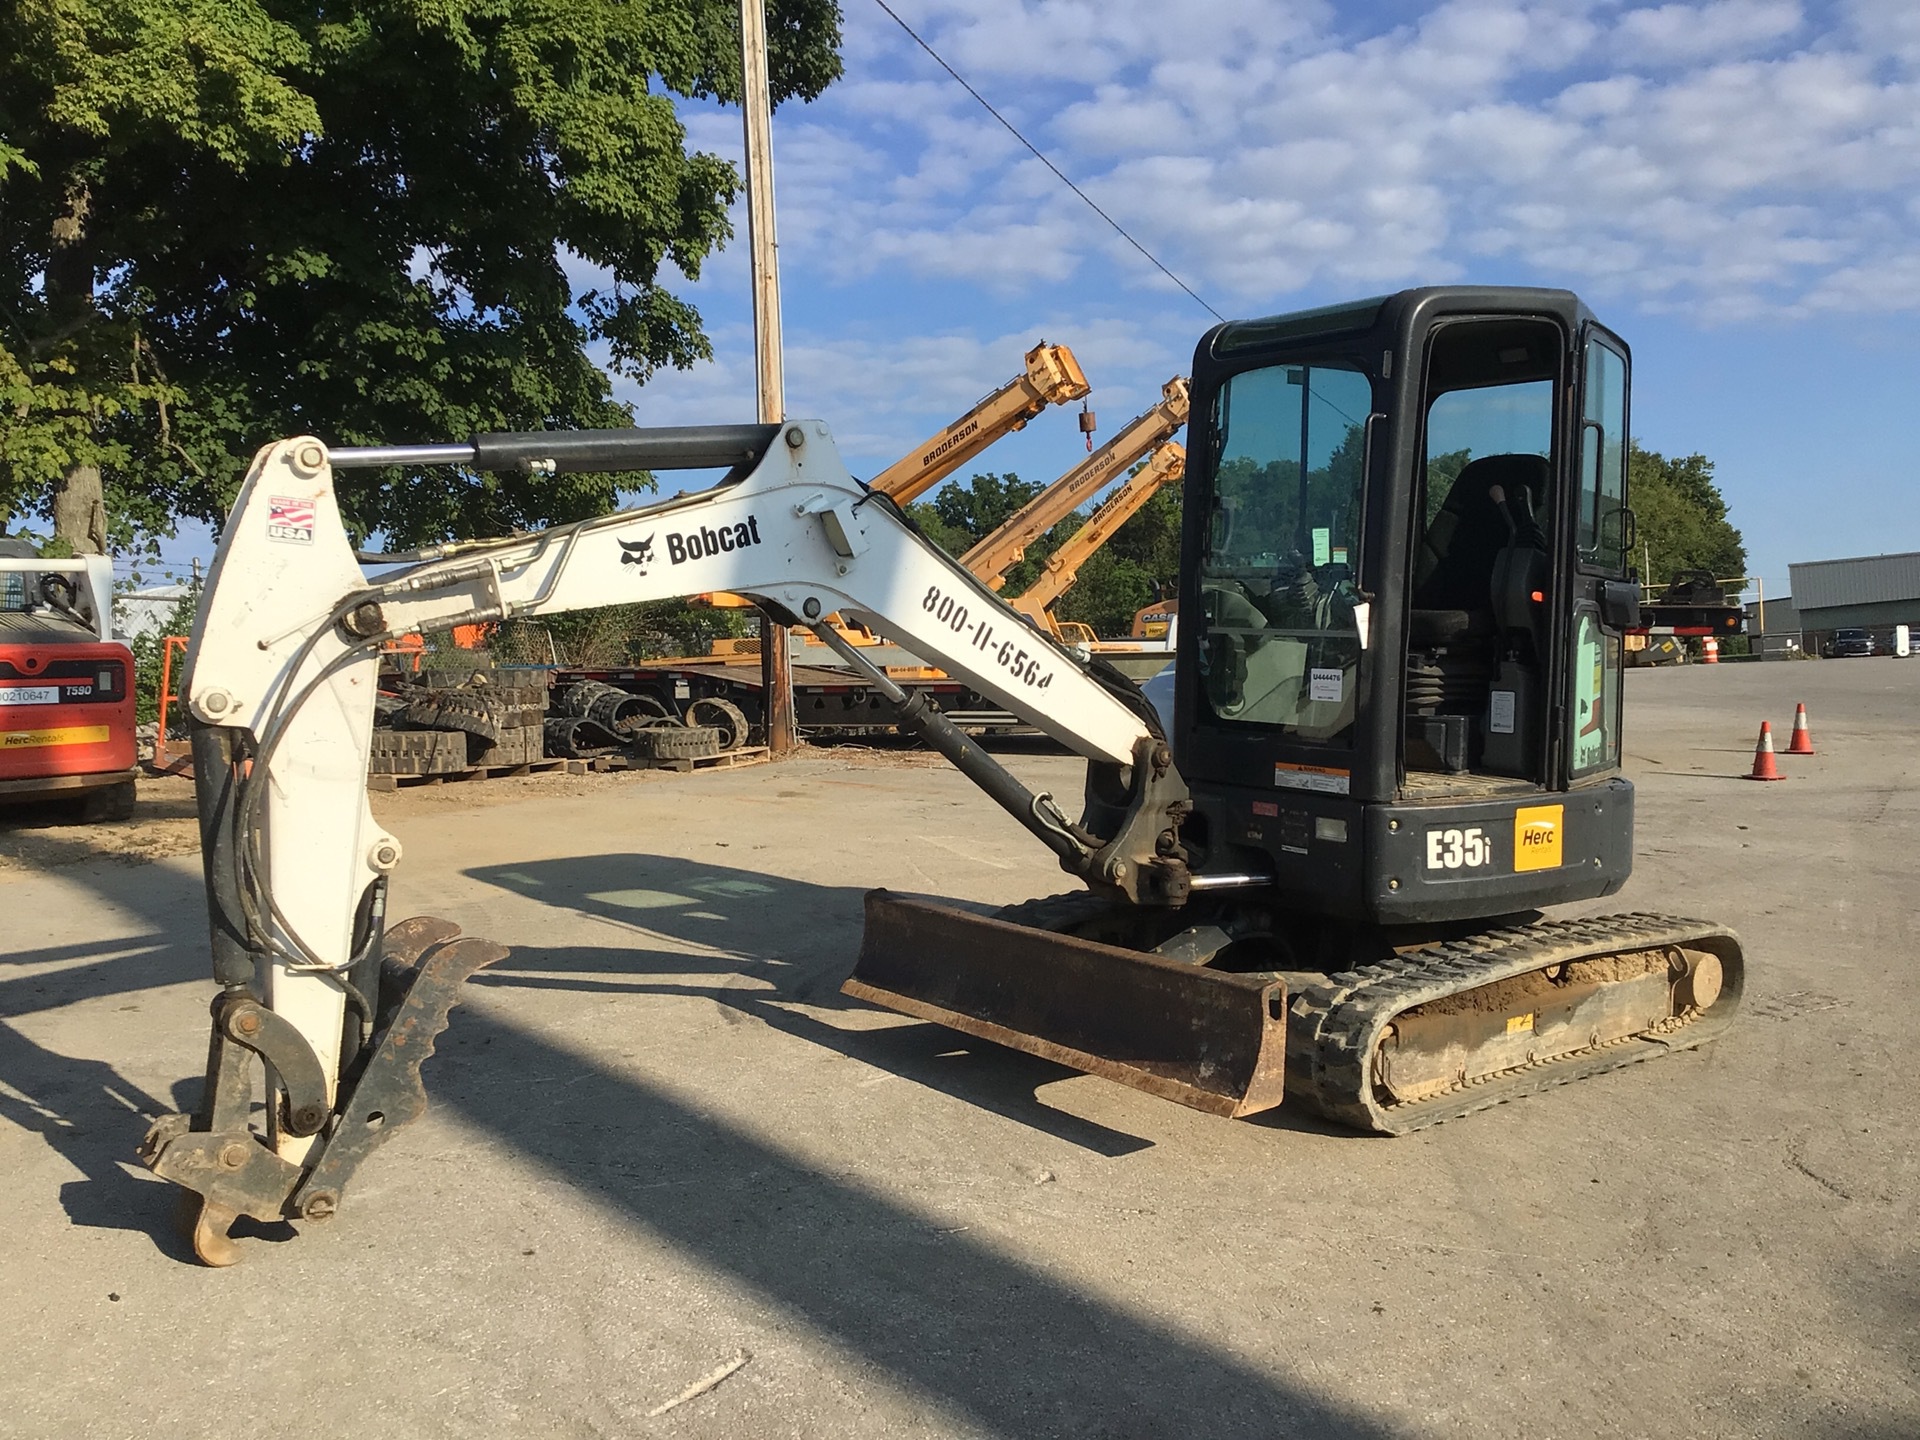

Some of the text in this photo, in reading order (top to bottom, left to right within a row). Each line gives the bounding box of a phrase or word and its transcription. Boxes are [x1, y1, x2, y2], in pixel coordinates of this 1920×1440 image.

[923, 420, 978, 466] BRODERSON
[1068, 452, 1116, 492] BRODERSON
[1092, 484, 1133, 525] BRODERSON
[270, 525, 311, 541] USA
[666, 514, 762, 565] Bobcat
[922, 585, 1054, 690] 800-11-6564
[0, 690, 49, 702] 0210647
[66, 685, 92, 696] T590
[1426, 827, 1492, 870] E35i
[1523, 829, 1554, 847] Herc
